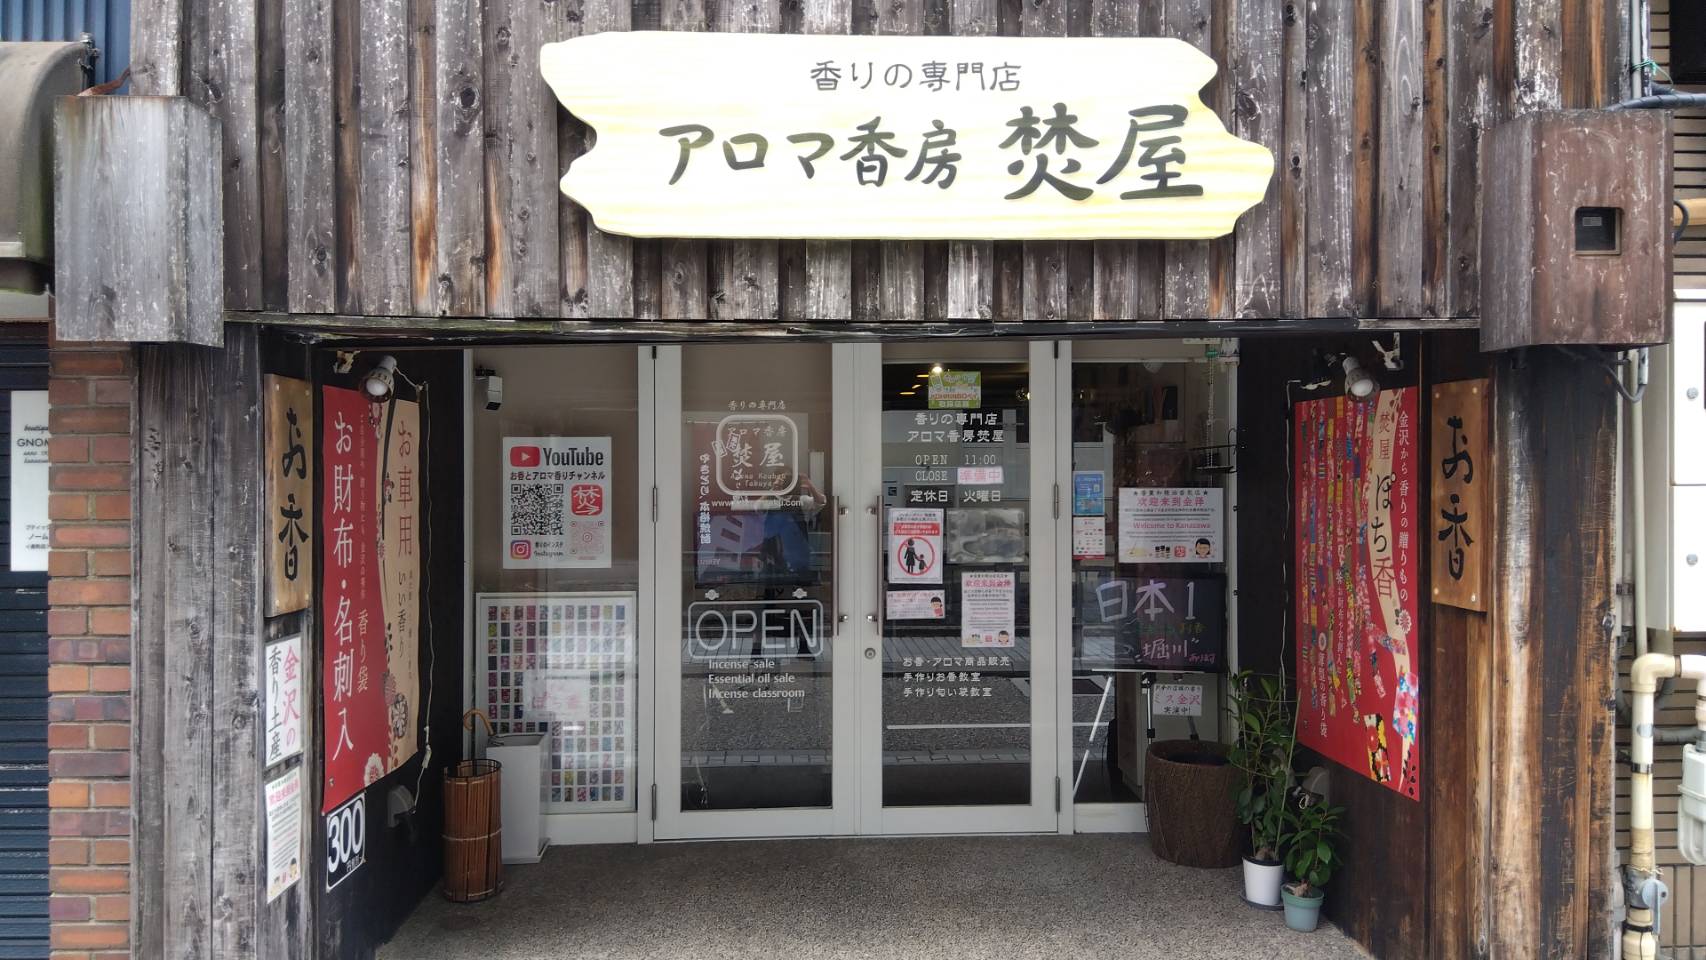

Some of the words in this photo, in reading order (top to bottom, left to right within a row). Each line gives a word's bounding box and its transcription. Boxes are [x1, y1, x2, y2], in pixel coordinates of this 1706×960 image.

[809, 60, 1023, 92] 香りの専門店
[659, 115, 962, 190] アロマ香房
[998, 103, 1204, 201] 焚屋
[728, 400, 786, 410] 香りの専門店
[914, 413, 998, 425] 香りの専門店
[907, 430, 1005, 443] アロマ香房焚屋
[543, 447, 604, 466] YouTube
[915, 455, 948, 465] OPEN
[964, 455, 996, 465] 11:00
[915, 471, 948, 481] CLOSE
[279, 407, 310, 581] お香
[910, 490, 948, 502] 定休日
[963, 490, 1001, 502] 火曜日
[1438, 416, 1474, 581] お香
[696, 609, 817, 650] OPEN
[708, 660, 748, 669] Incense
[753, 660, 775, 669] sale
[903, 656, 1010, 667] お香・アロマ商品販売
[708, 674, 754, 684] Essential
[757, 674, 770, 683] oil
[774, 673, 795, 683] sale
[903, 672, 981, 682] 手作りお香教室
[282, 645, 300, 746] 金沢の
[708, 688, 748, 699] Incense
[752, 688, 805, 698] classroom
[268, 646, 282, 761] 香り土産
[328, 799, 363, 873] 300
